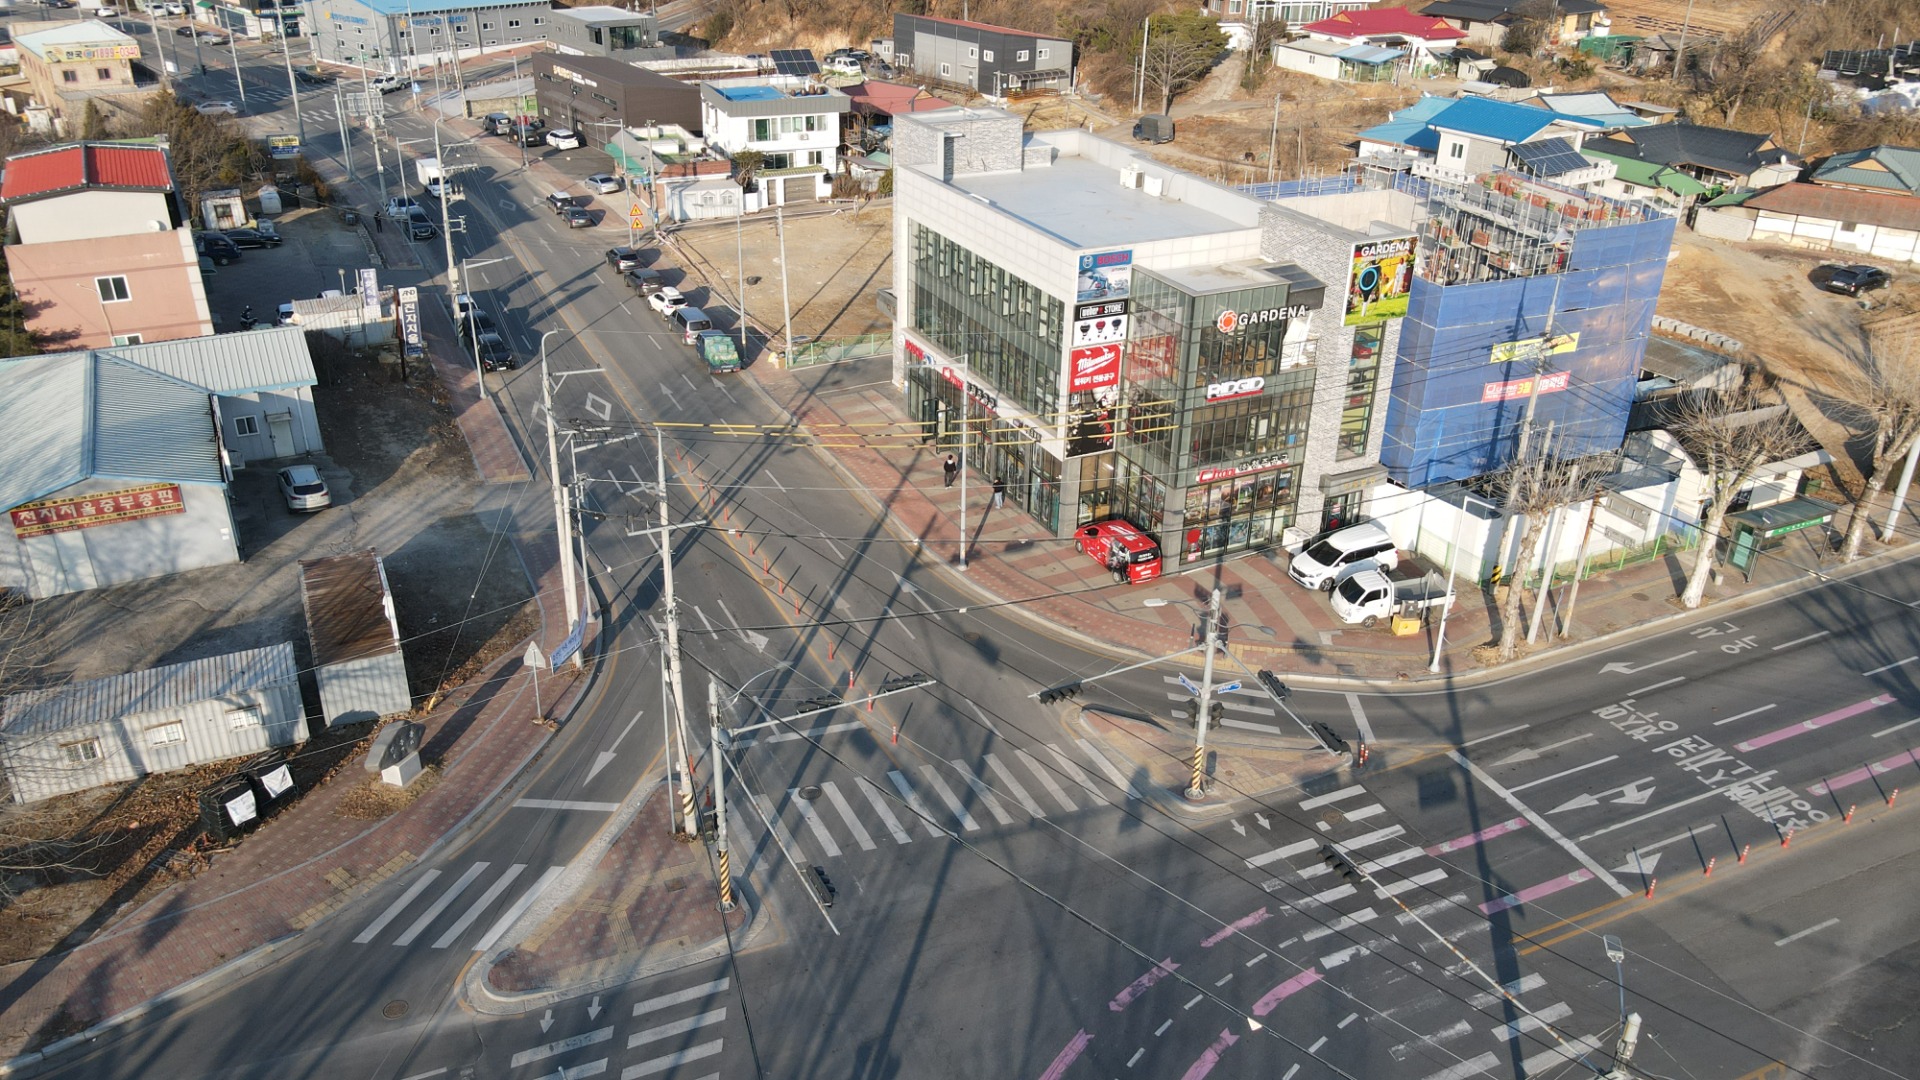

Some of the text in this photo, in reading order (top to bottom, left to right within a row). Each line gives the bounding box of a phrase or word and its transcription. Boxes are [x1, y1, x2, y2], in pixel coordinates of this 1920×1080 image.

[1360, 241, 1410, 257] GARDENA
[1096, 253, 1129, 266] BOSCH
[1104, 303, 1123, 314] STORE
[1238, 306, 1307, 326] GARDENA
[404, 303, 420, 344] 전자저울
[1074, 372, 1116, 387] 밀워키 전동공구
[1207, 377, 1265, 400] RIDGID
[1651, 734, 1759, 789] 조치원
